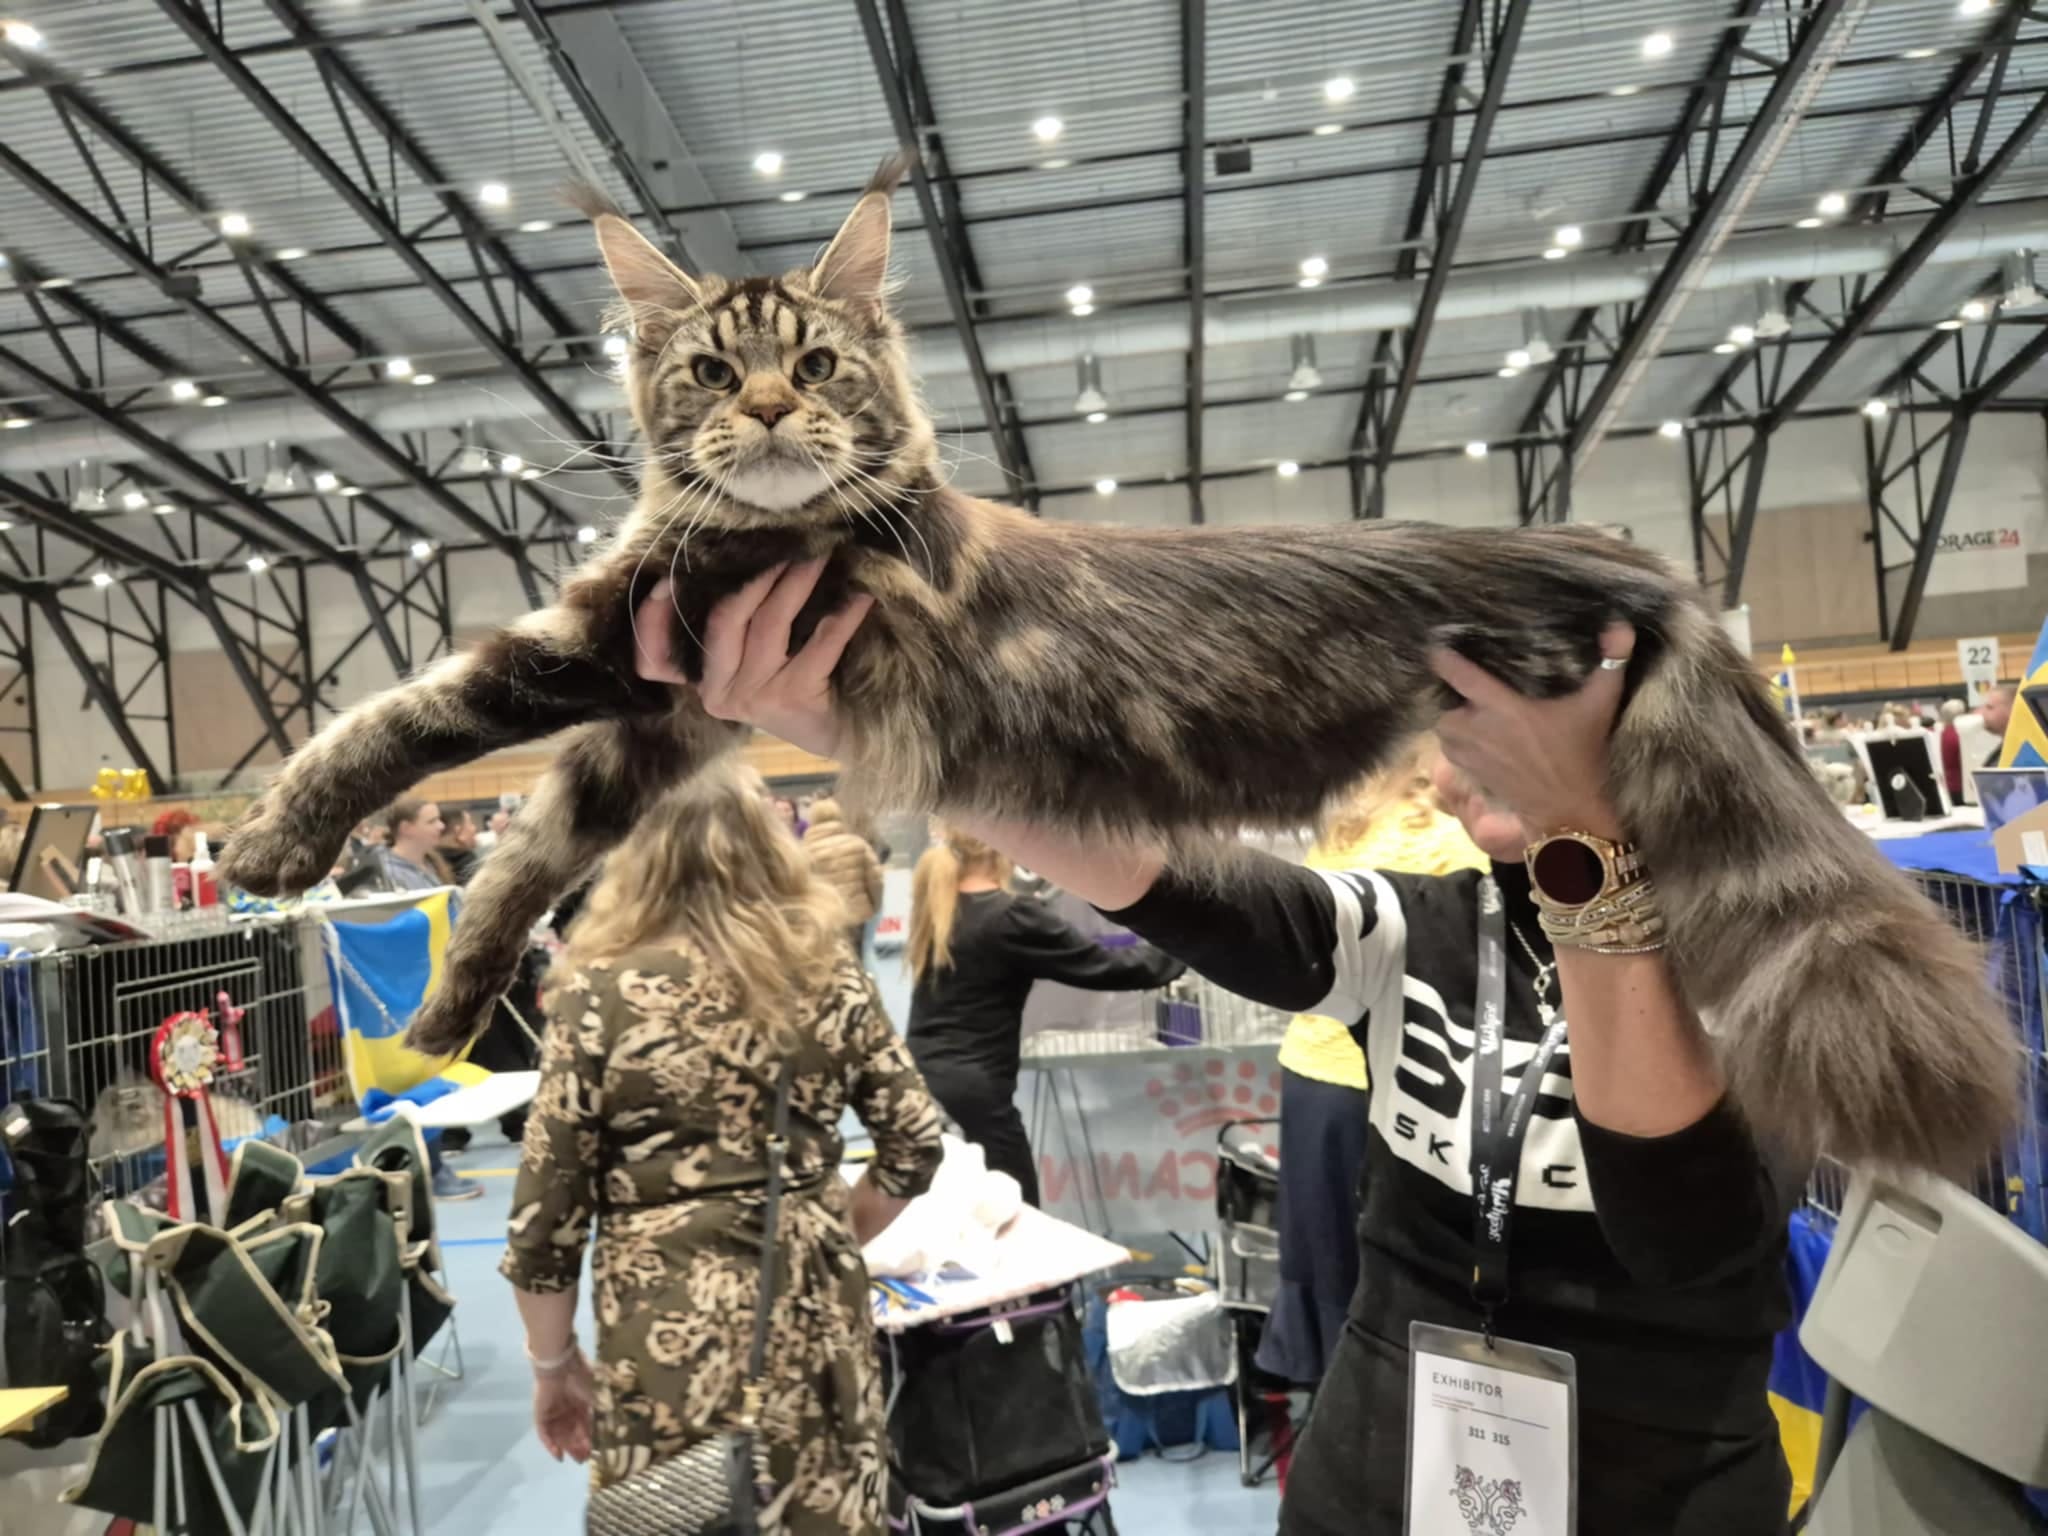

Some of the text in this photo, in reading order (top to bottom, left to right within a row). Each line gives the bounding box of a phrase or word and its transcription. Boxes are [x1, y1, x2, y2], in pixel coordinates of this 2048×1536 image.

[1967, 646, 1992, 666] 22
[1431, 1371, 1504, 1399] EXHIBITOR
[1468, 1425, 1486, 1440] 311
